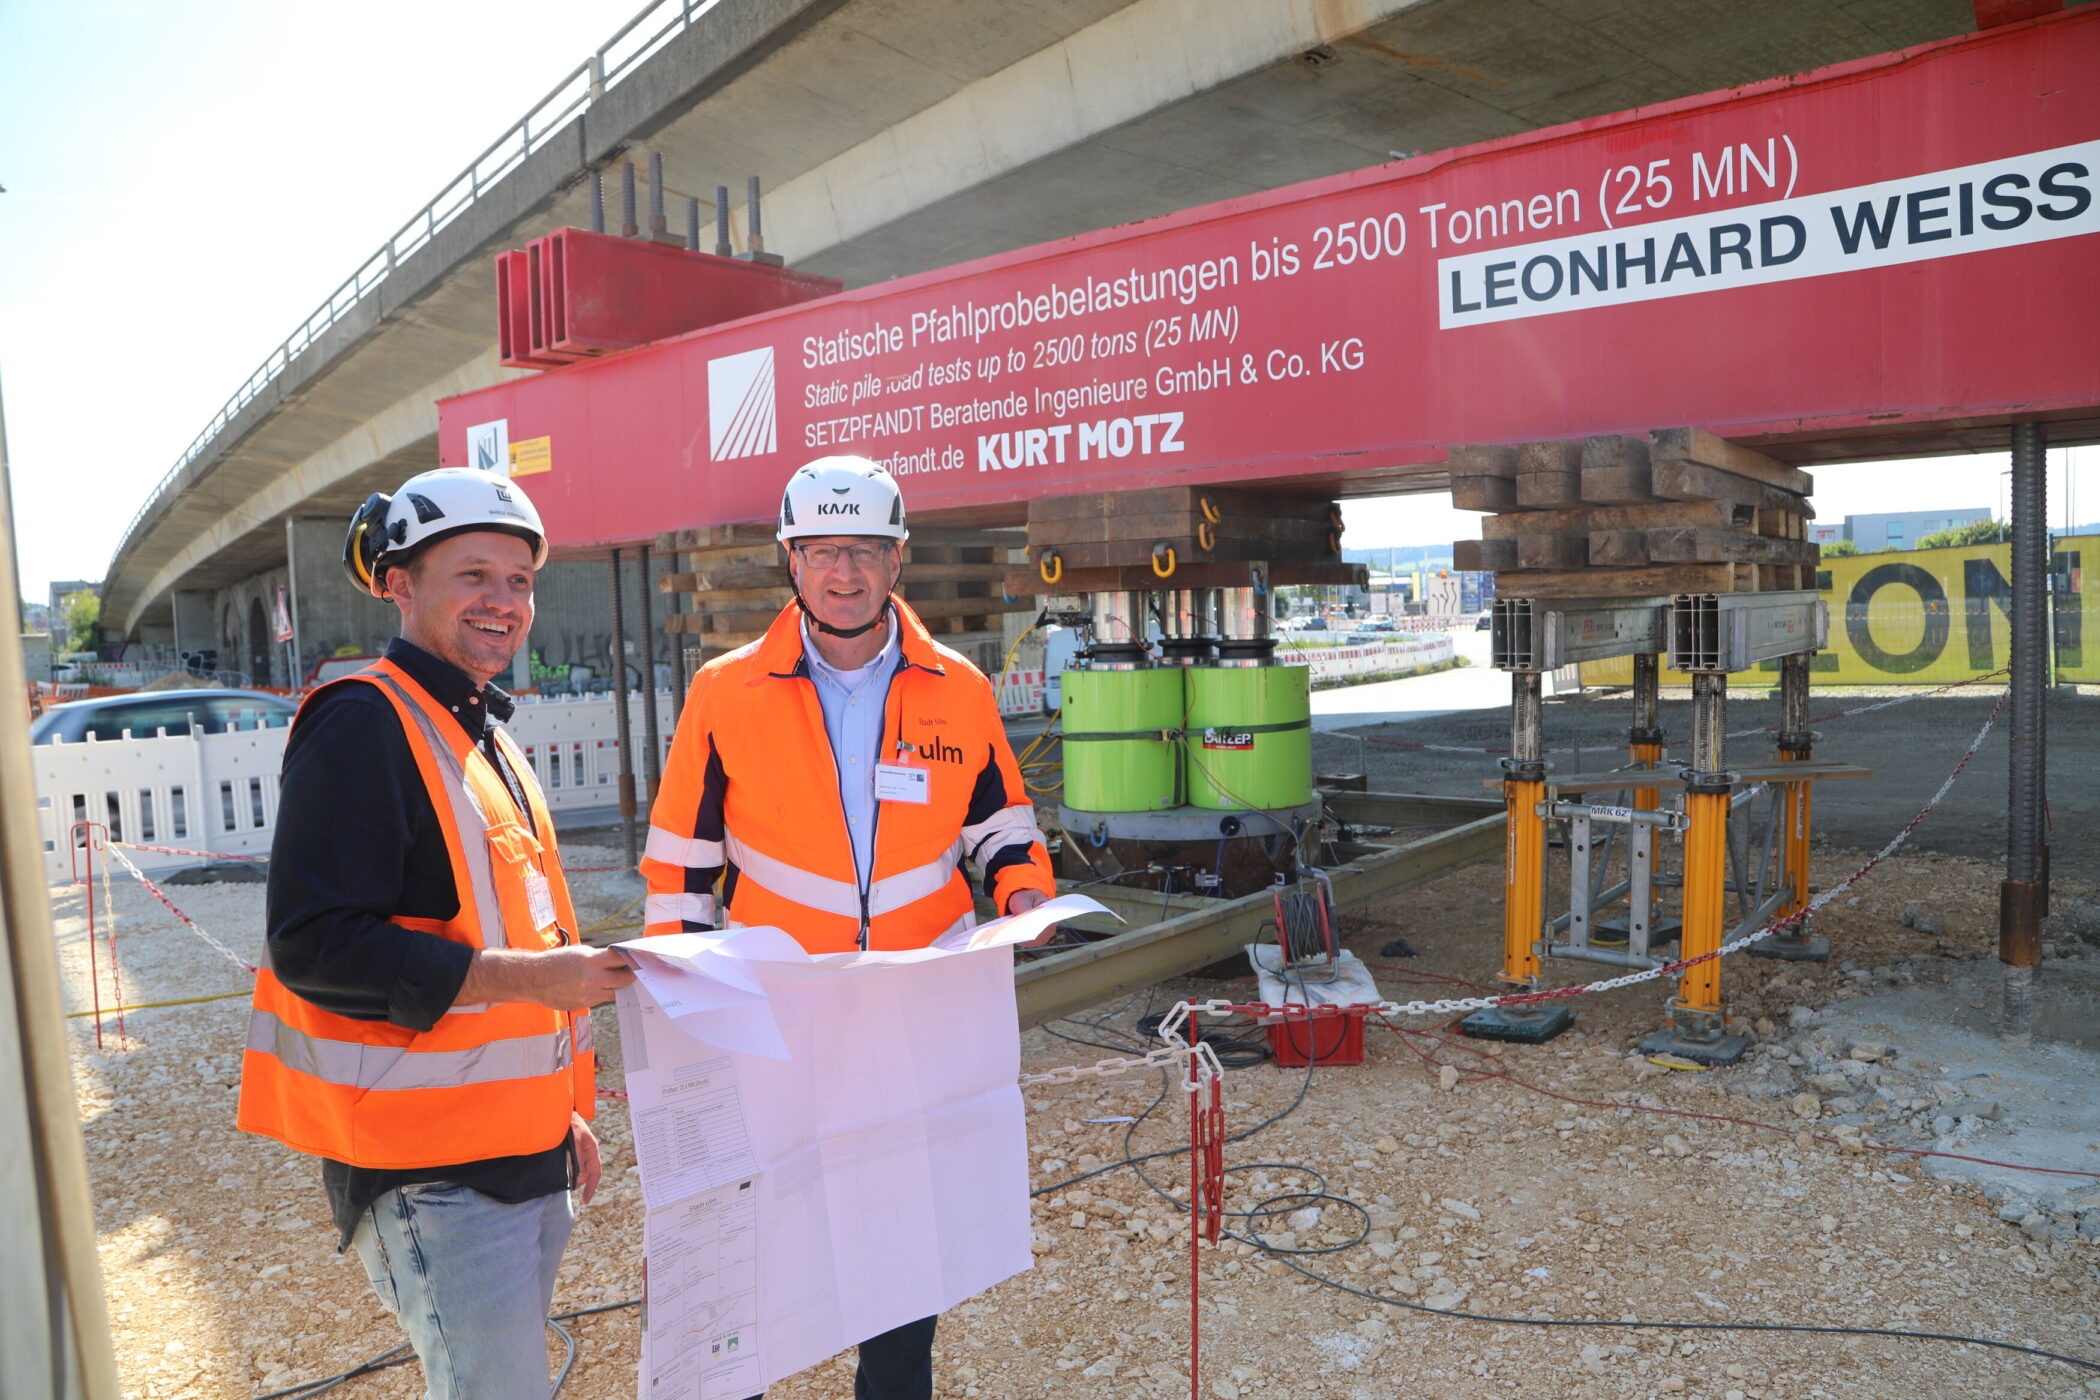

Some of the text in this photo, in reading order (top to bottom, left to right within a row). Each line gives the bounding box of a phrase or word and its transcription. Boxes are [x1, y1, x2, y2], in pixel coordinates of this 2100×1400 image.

[803, 134, 1799, 370] Statische Pfahlprobebelastungen bis 2500 Tonnen (25 MN)
[1451, 162, 2092, 314] LEONHARD WEISS
[804, 379, 849, 409] Static
[852, 373, 882, 407] pile
[927, 356, 972, 387] tests
[977, 355, 1002, 384] up
[1007, 347, 1026, 374] to
[1032, 333, 1085, 369] 2500
[1090, 330, 1138, 360] tons
[1144, 315, 1182, 358] (25
[1188, 304, 1239, 346] MN)
[804, 337, 1364, 448] SETZPFANDT Beratende Ingenieure GmbH & Co. KG
[977, 424, 1073, 473] KURT
[1078, 411, 1185, 461] MOTZ
[818, 503, 860, 515] KASK
[919, 735, 964, 765] ulm
[1591, 806, 1613, 816] MRK
